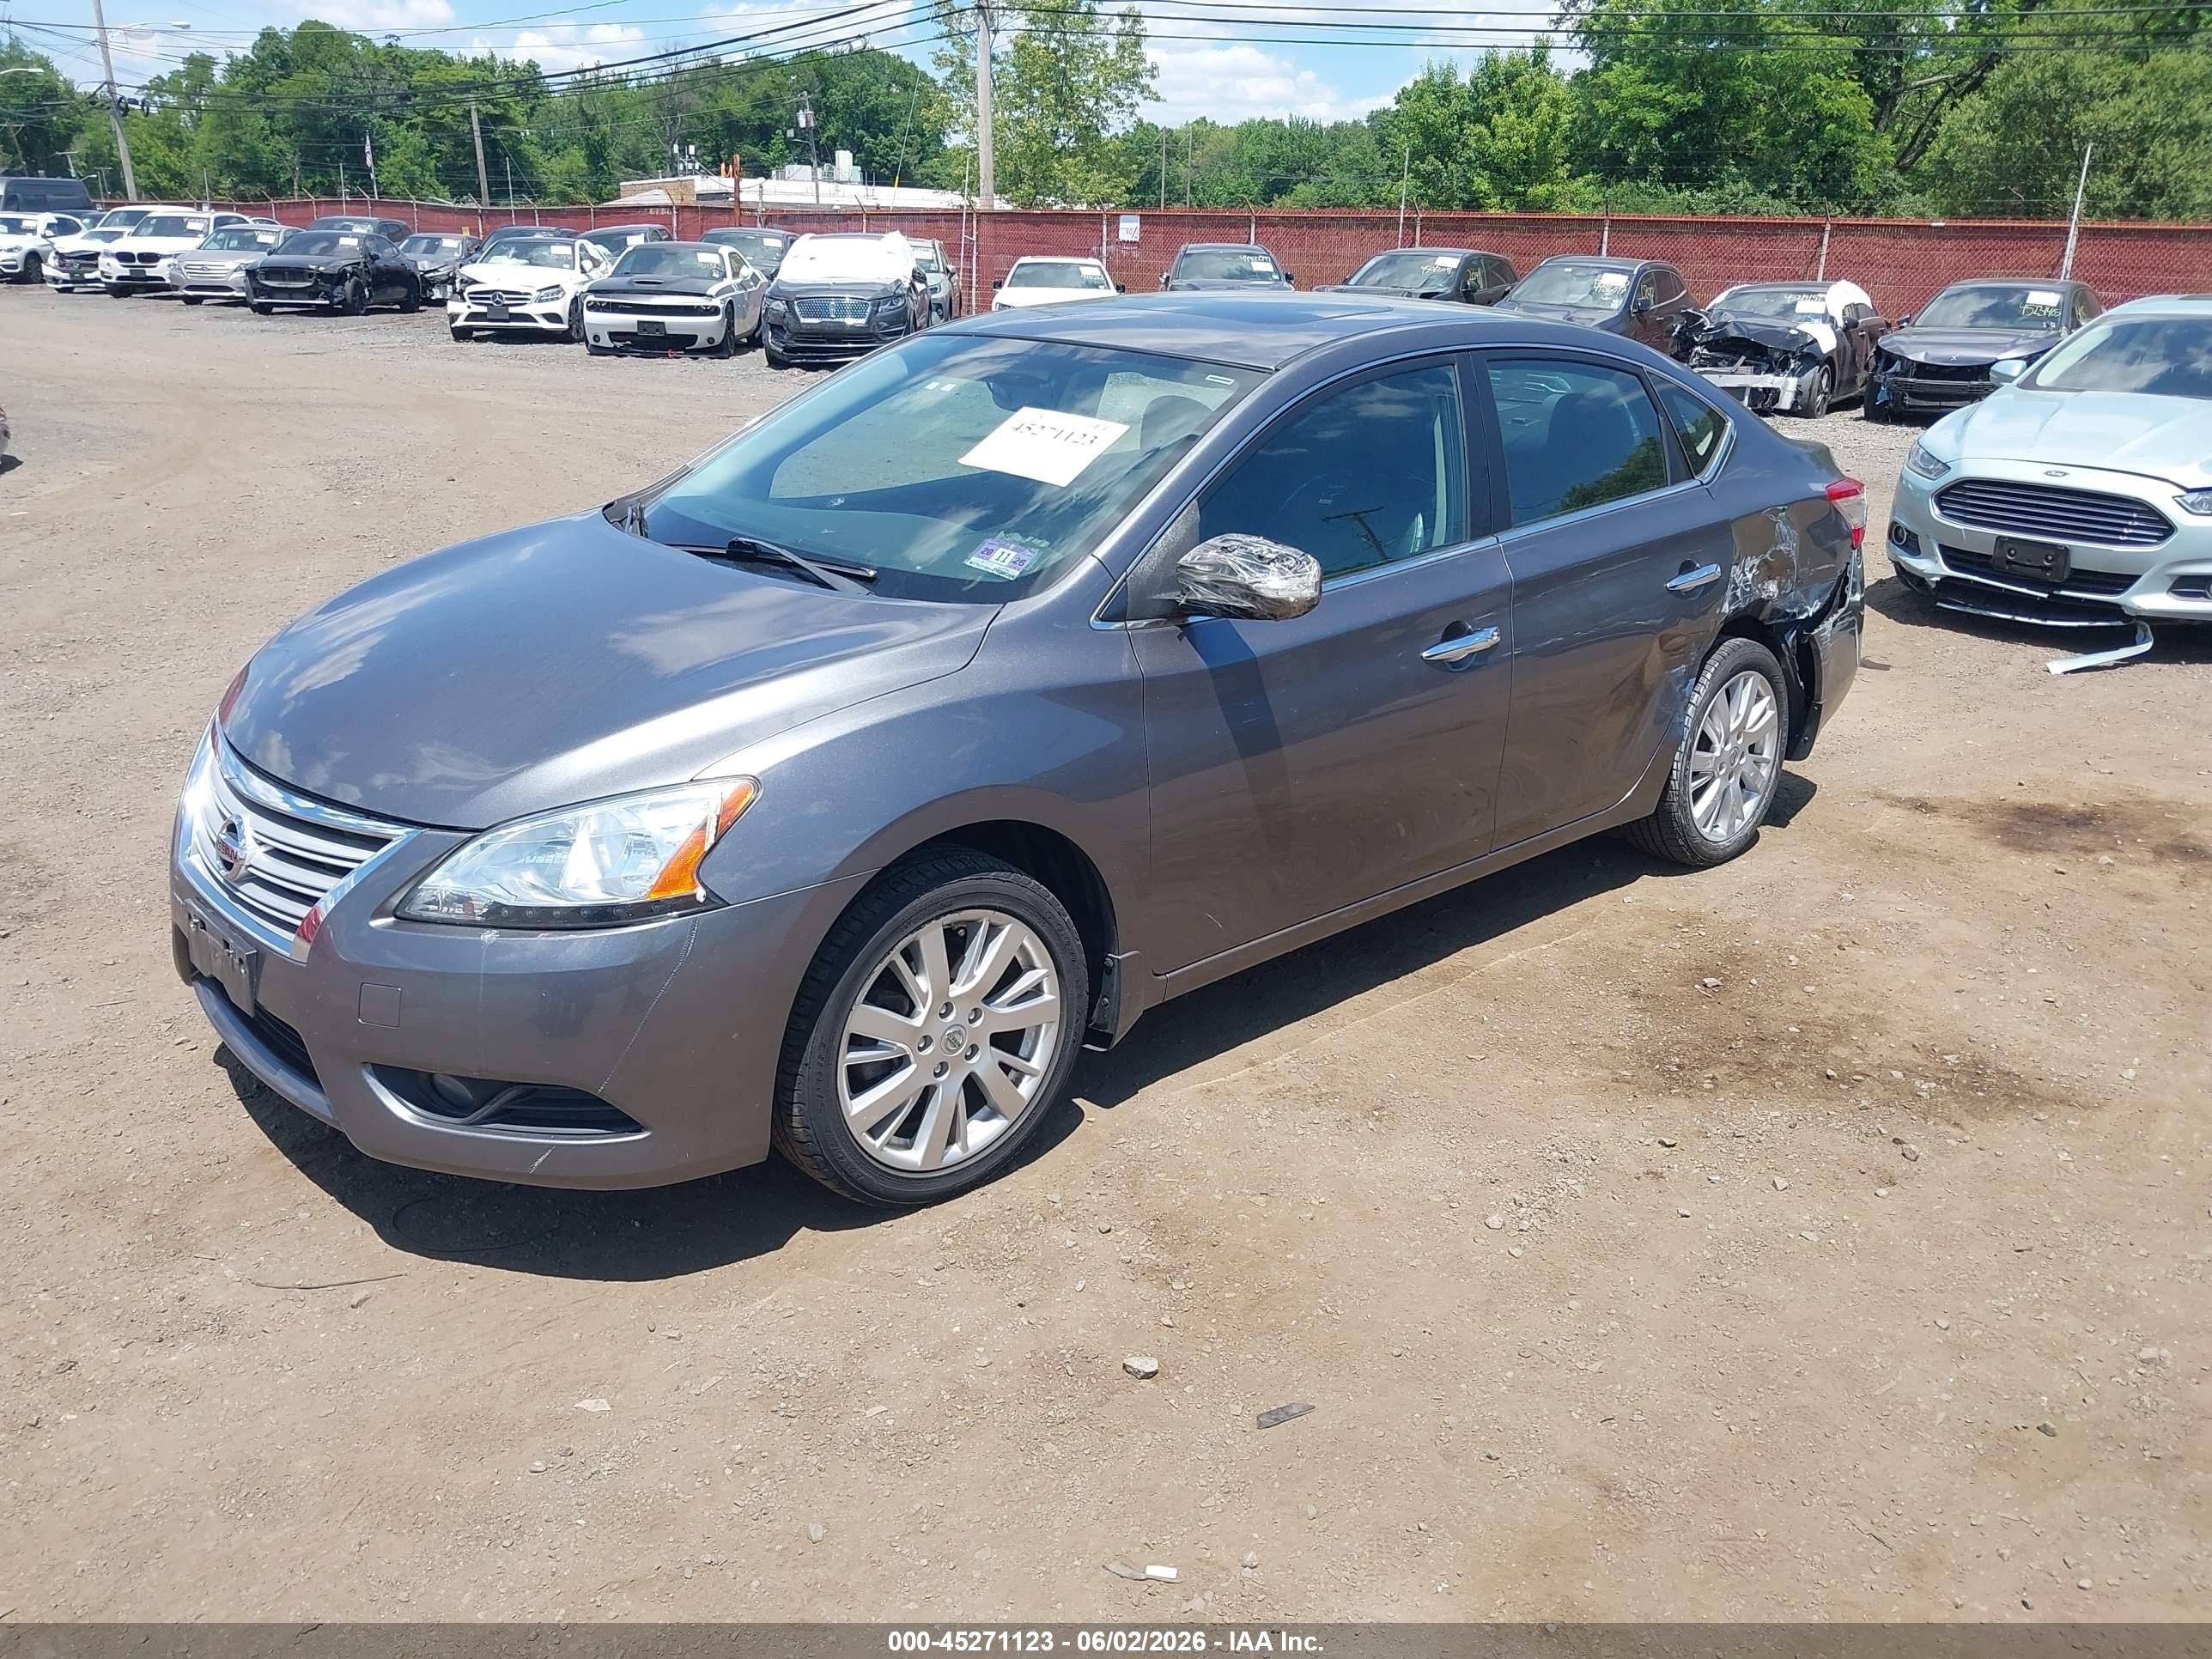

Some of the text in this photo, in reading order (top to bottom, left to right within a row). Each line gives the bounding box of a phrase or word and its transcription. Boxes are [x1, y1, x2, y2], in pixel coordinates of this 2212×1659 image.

[981, 547, 1027, 567] 20 11 26
